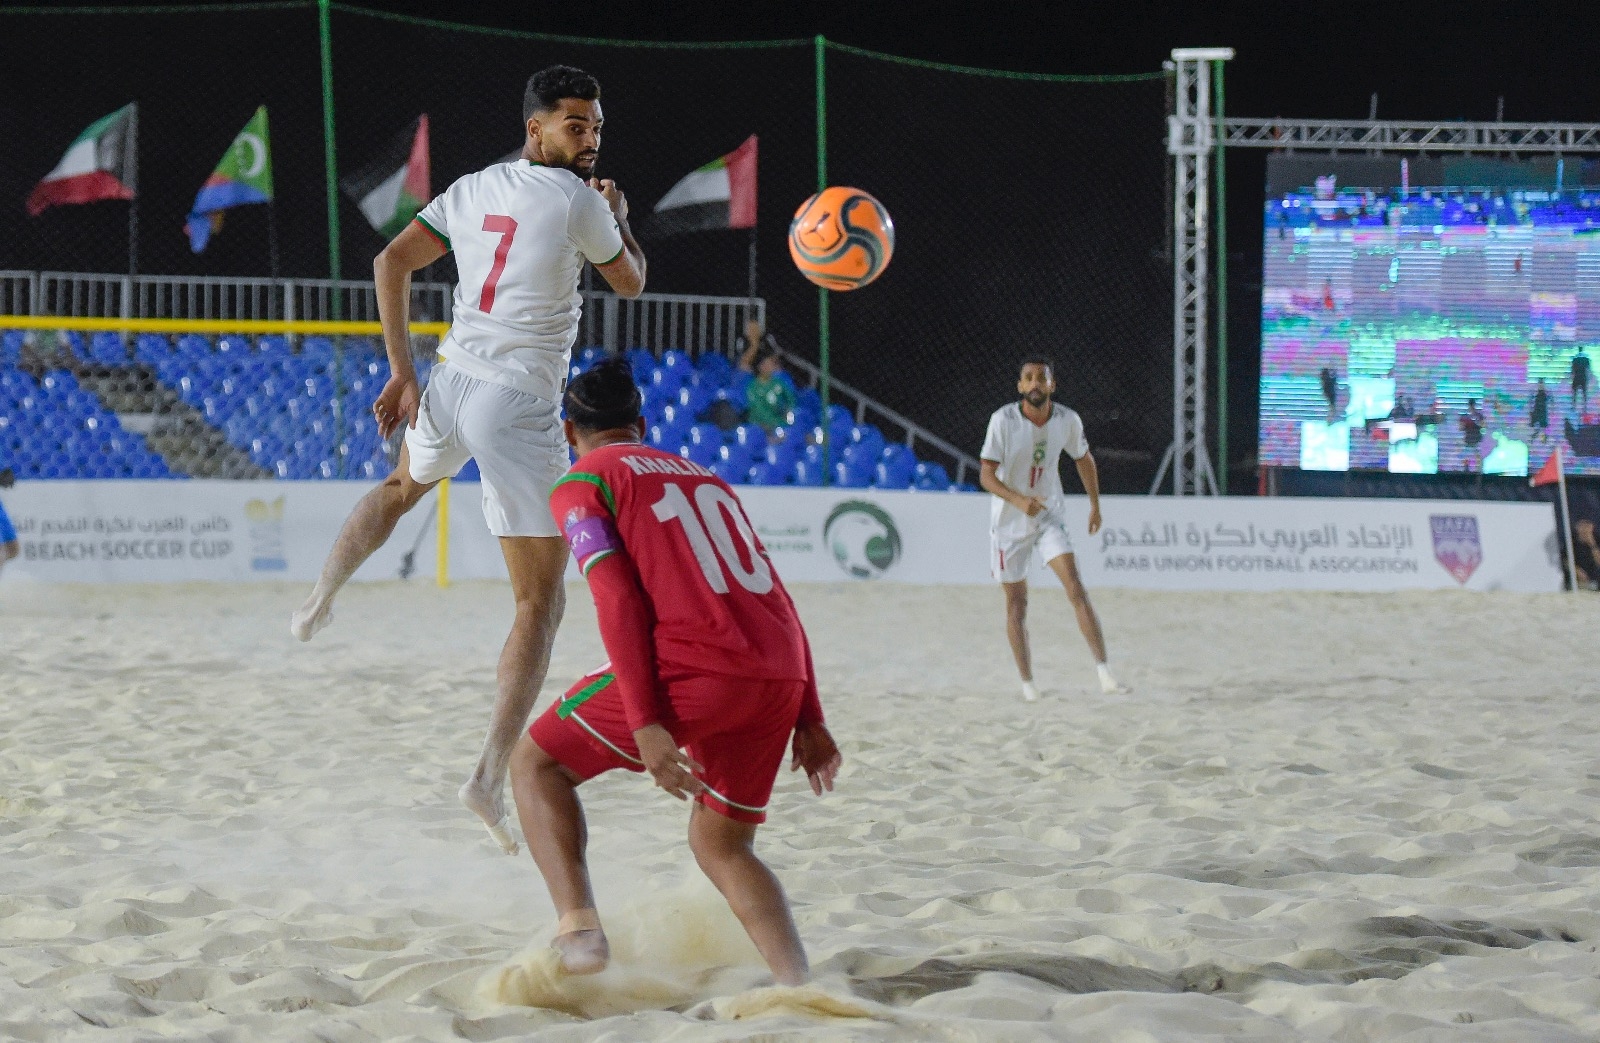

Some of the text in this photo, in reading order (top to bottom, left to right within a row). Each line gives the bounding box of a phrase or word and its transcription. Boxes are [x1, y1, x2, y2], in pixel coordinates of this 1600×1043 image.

[479, 213, 518, 314] 7
[24, 539, 233, 560] BEACH SOCCER CUP
[651, 483, 774, 594] 10
[1100, 521, 1178, 552] القدم
[1184, 521, 1256, 552] لكرة
[1259, 522, 1338, 554] العربي
[1103, 555, 1418, 574] ARAB UNION FOOTBALL ASSOCIATION
